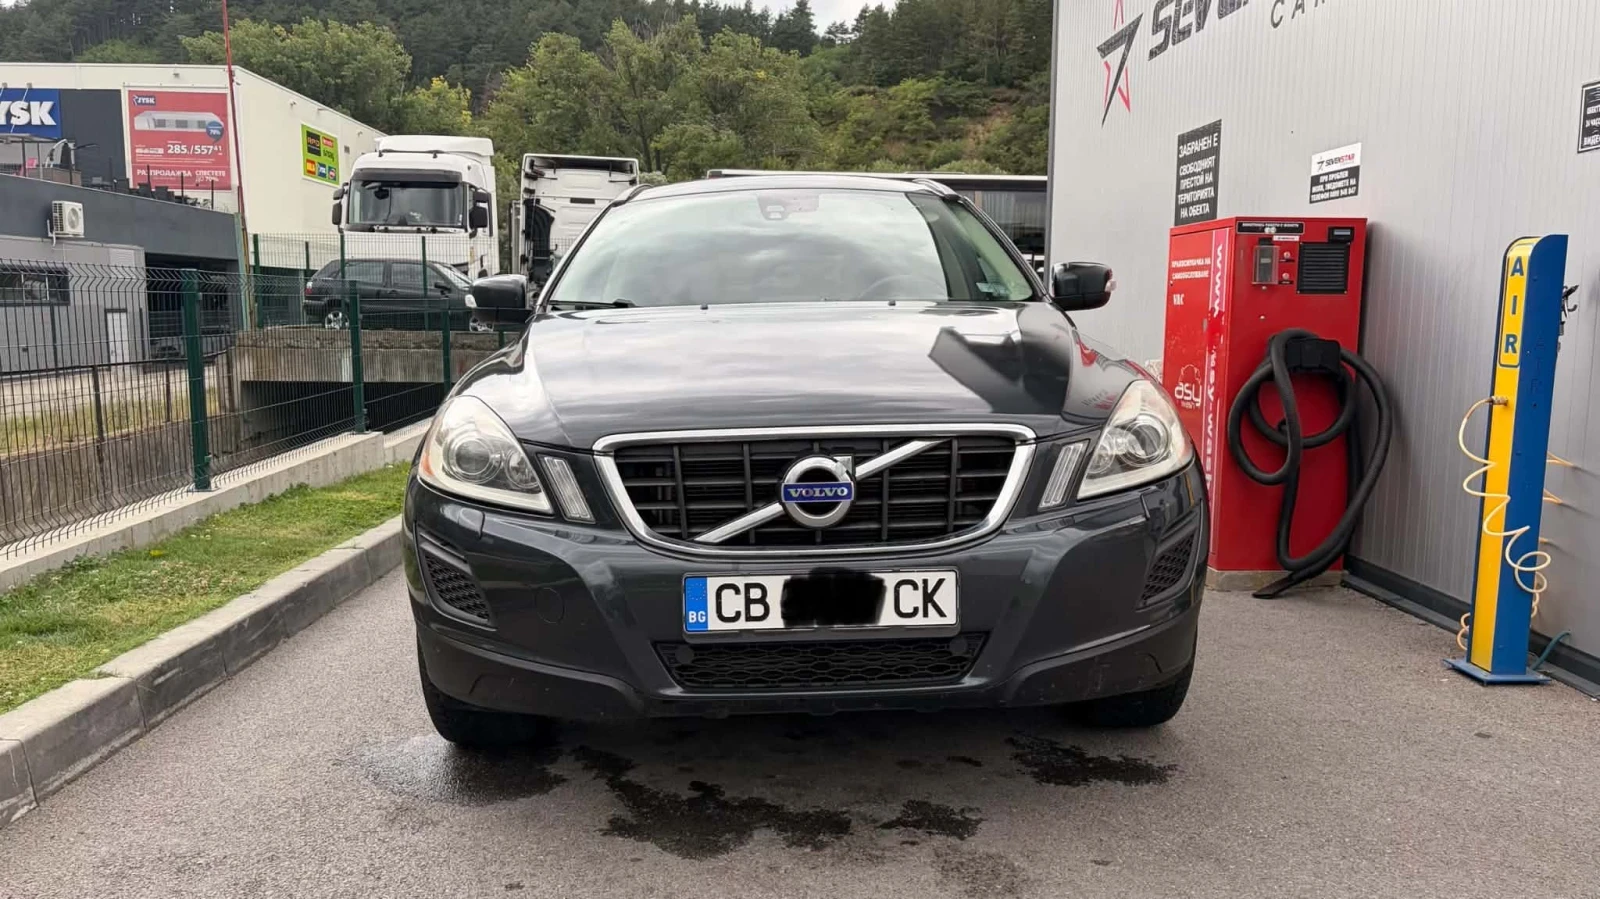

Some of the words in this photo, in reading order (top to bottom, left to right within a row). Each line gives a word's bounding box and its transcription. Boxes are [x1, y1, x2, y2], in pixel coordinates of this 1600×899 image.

[1271, 0, 1325, 28] CA
[1148, 0, 1248, 61] SEV
[1179, 134, 1212, 158] ЗАБРАНЕН
[1213, 132, 1219, 147] Е
[1179, 155, 1216, 176] СВОБОДНИЯТ
[1180, 172, 1204, 190] ПРЕСТОЙ
[1204, 171, 1213, 184] НА
[1178, 186, 1215, 205] ТЕРИТОРИЯТА
[1180, 207, 1188, 219] НА
[1188, 202, 1210, 217] ОБЕКТА
[787, 486, 849, 498] VOLVO
[715, 582, 770, 623] CB
[894, 578, 947, 618] CK
[688, 611, 707, 623] BG
